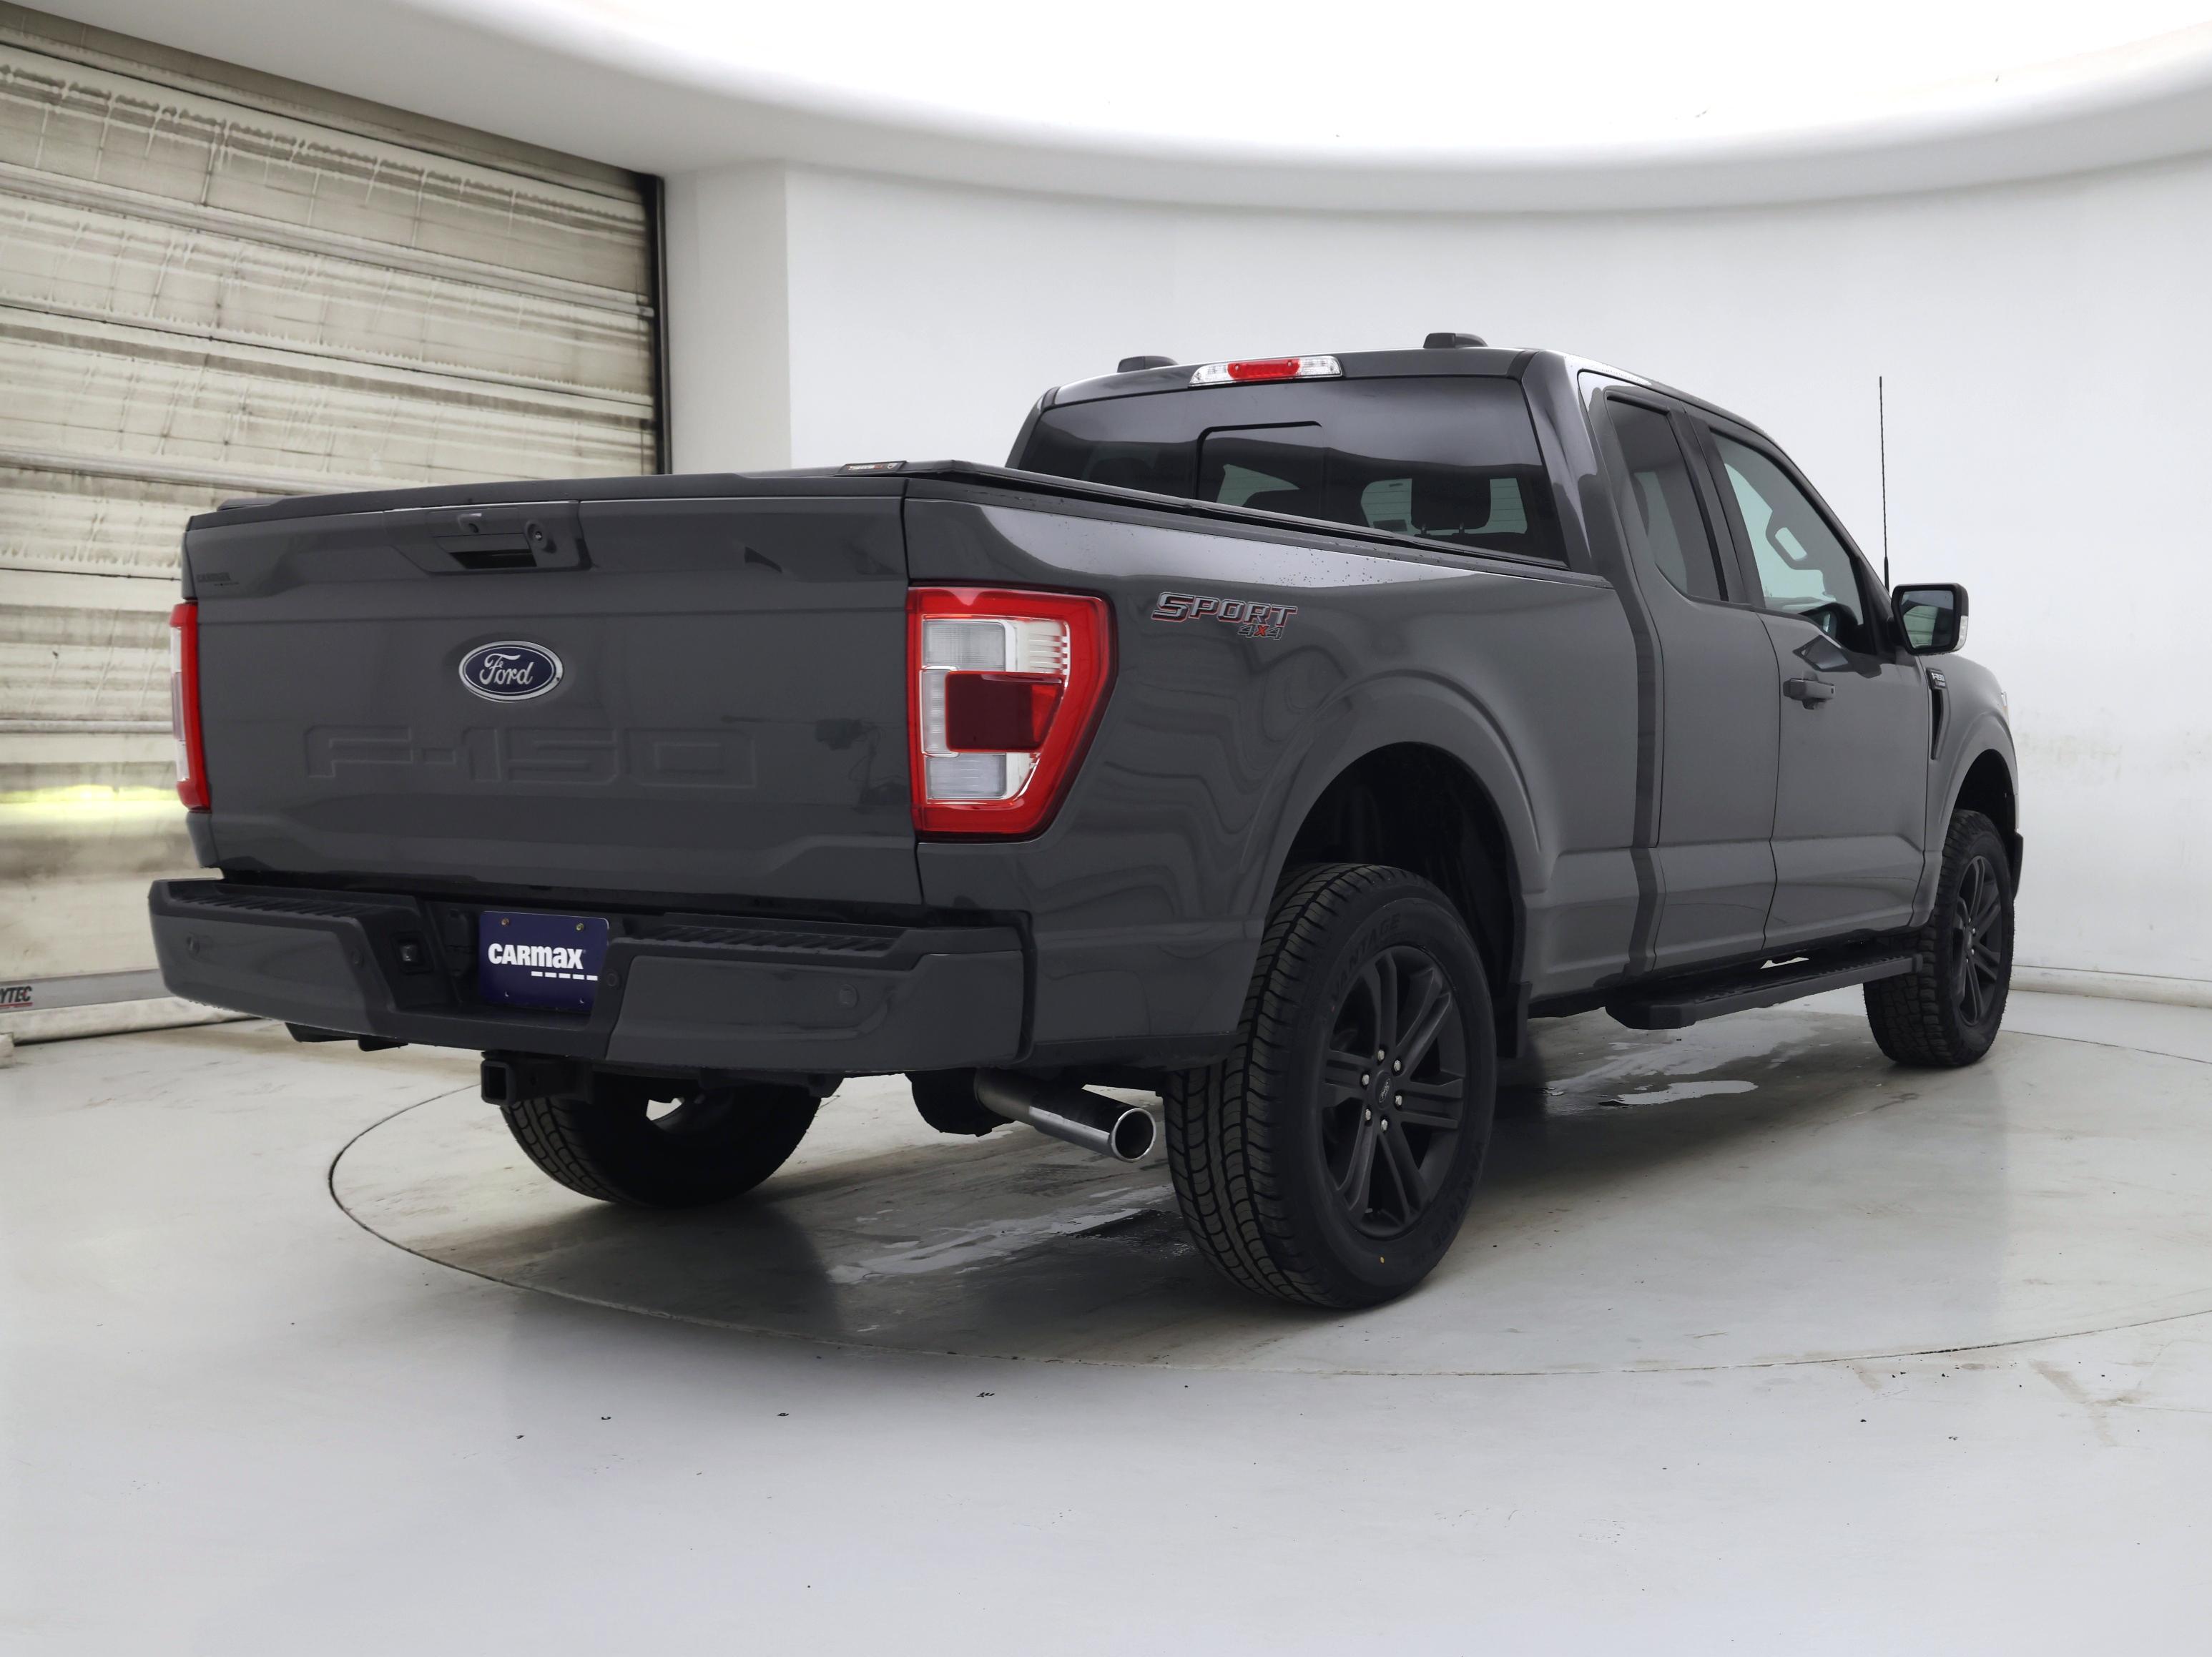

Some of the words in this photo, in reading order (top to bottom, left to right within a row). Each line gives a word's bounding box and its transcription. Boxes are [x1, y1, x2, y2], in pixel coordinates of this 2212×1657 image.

[1151, 591, 1298, 627] SPORT
[478, 653, 535, 685] Ford
[303, 724, 757, 787] F-150
[0, 985, 33, 1004] YTEC
